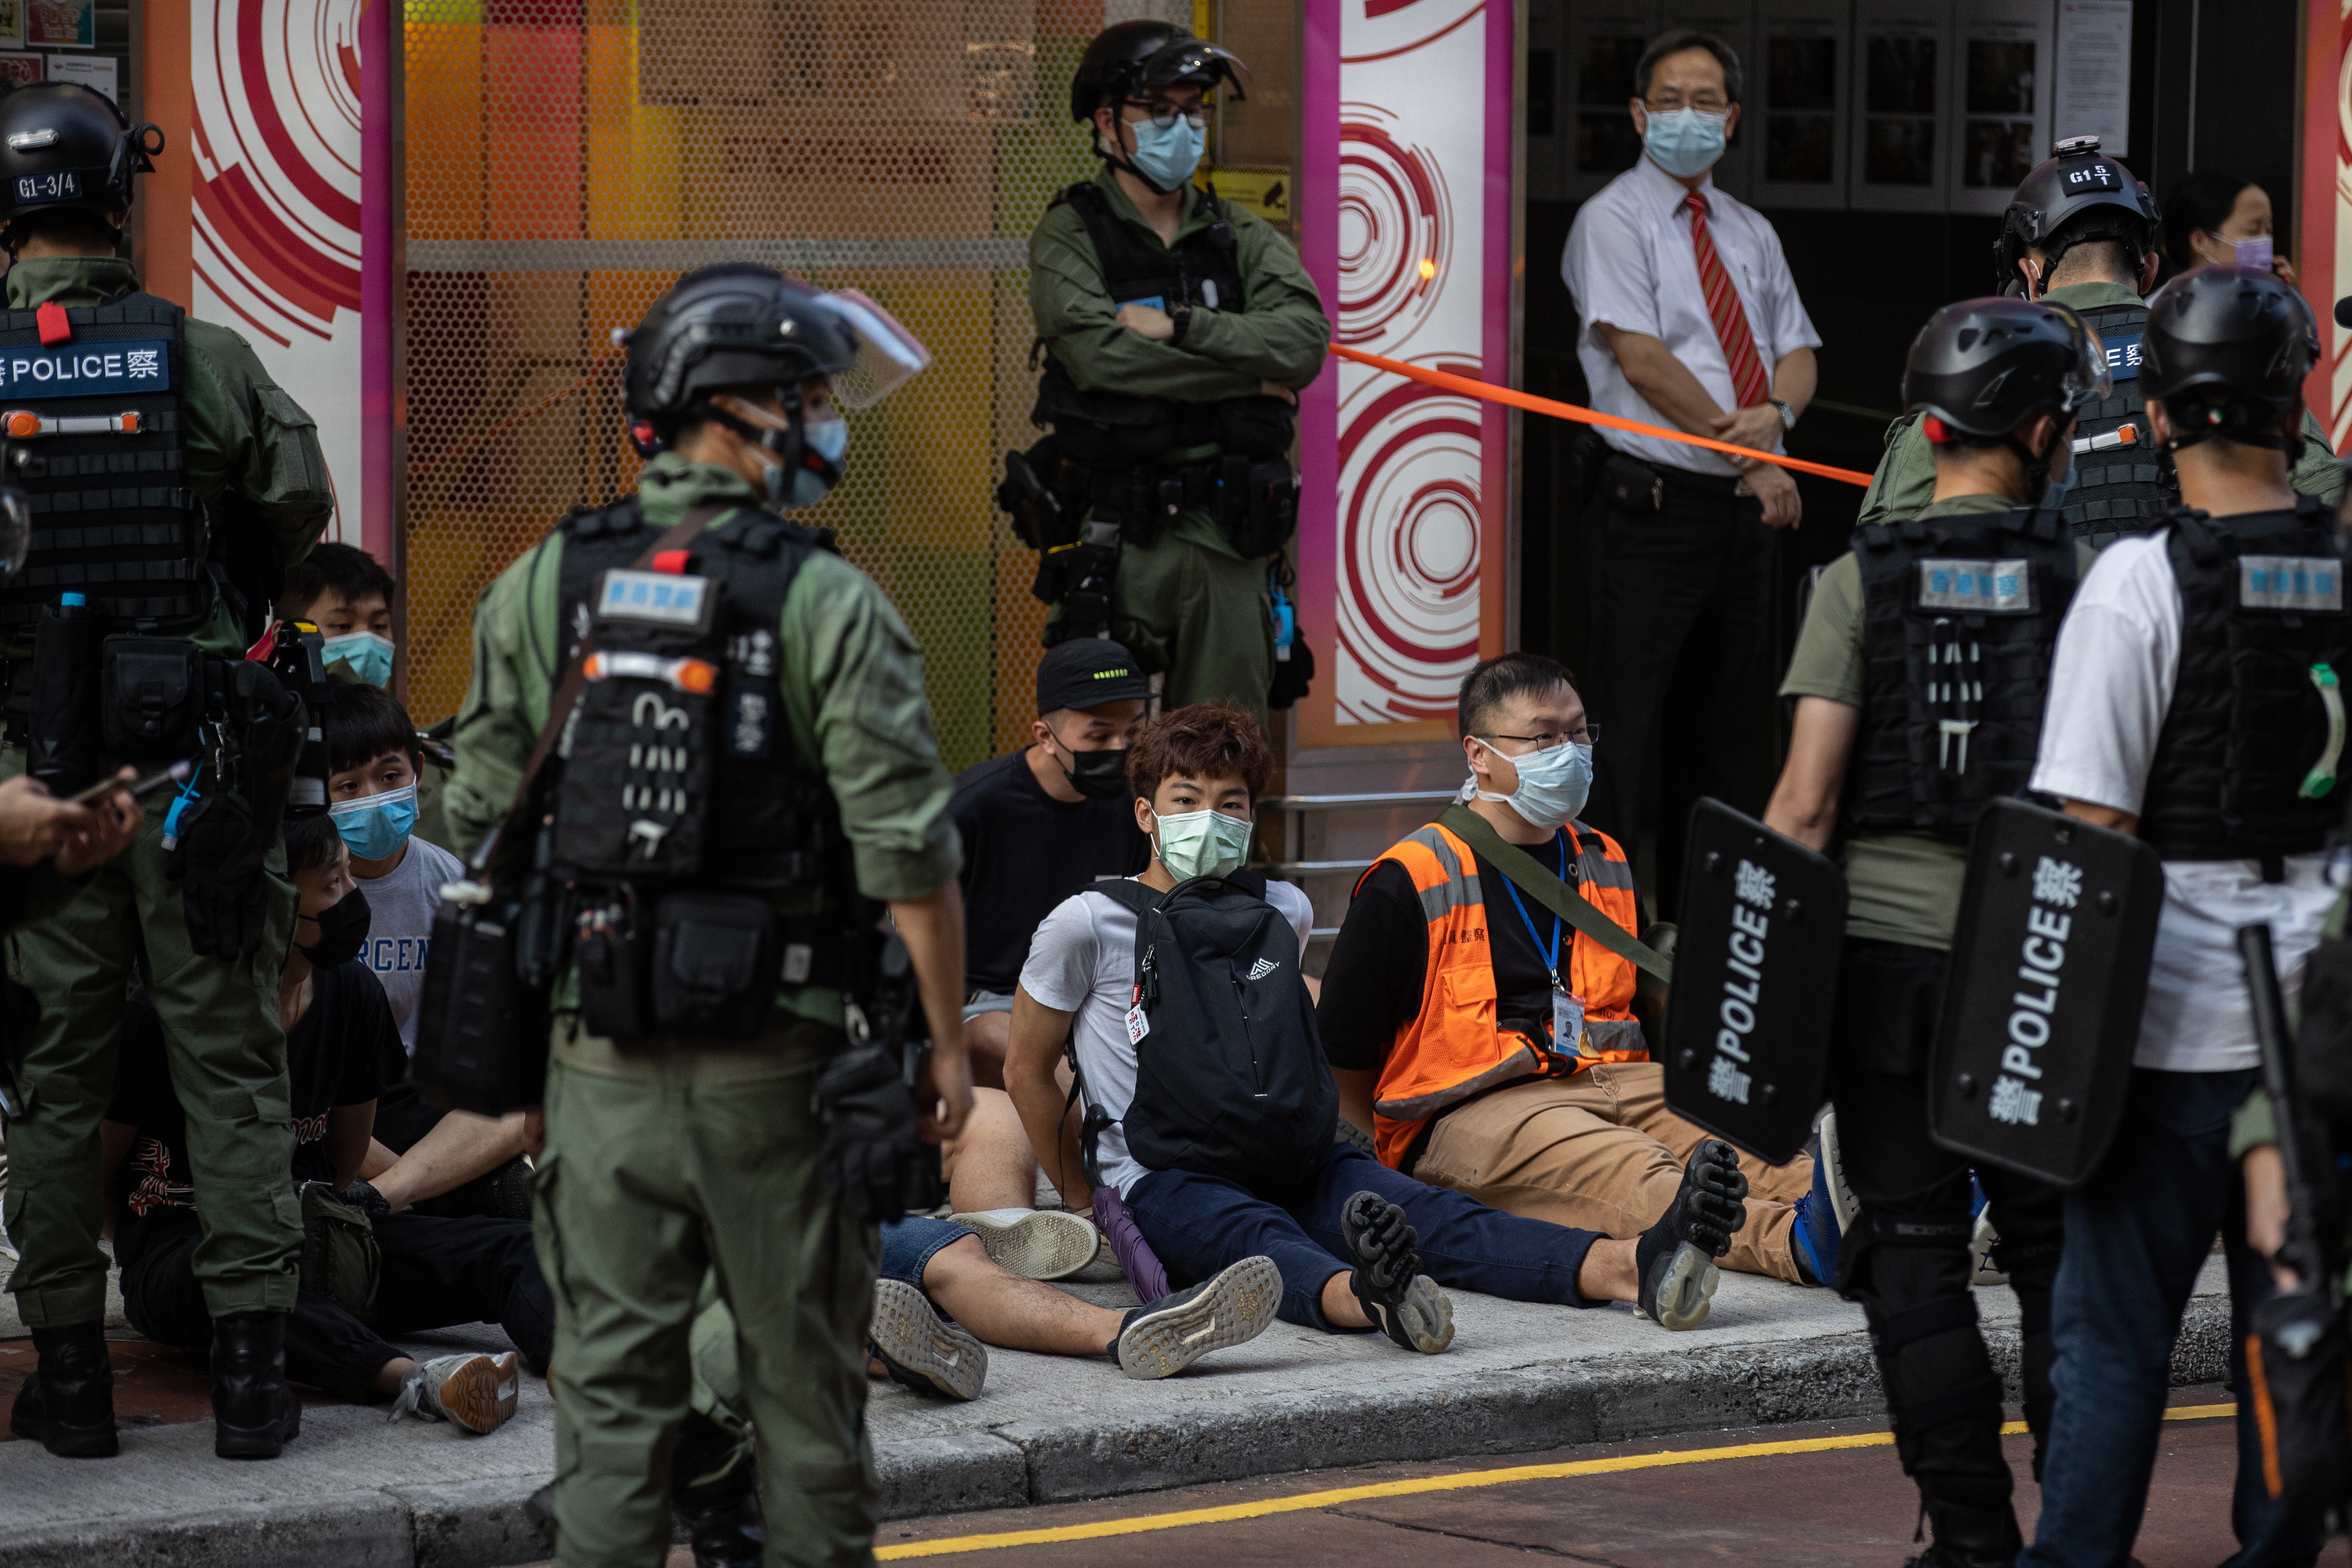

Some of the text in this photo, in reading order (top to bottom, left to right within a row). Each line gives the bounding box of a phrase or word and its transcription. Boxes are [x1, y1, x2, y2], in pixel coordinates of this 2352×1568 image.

[19, 172, 75, 198] G1-3/4
[12, 354, 123, 382] POLICE
[127, 349, 159, 379] 察
[1246, 961, 1279, 980] GREGORY
[1716, 903, 1769, 1063] POLICE
[2001, 905, 2072, 1080] POLICE
